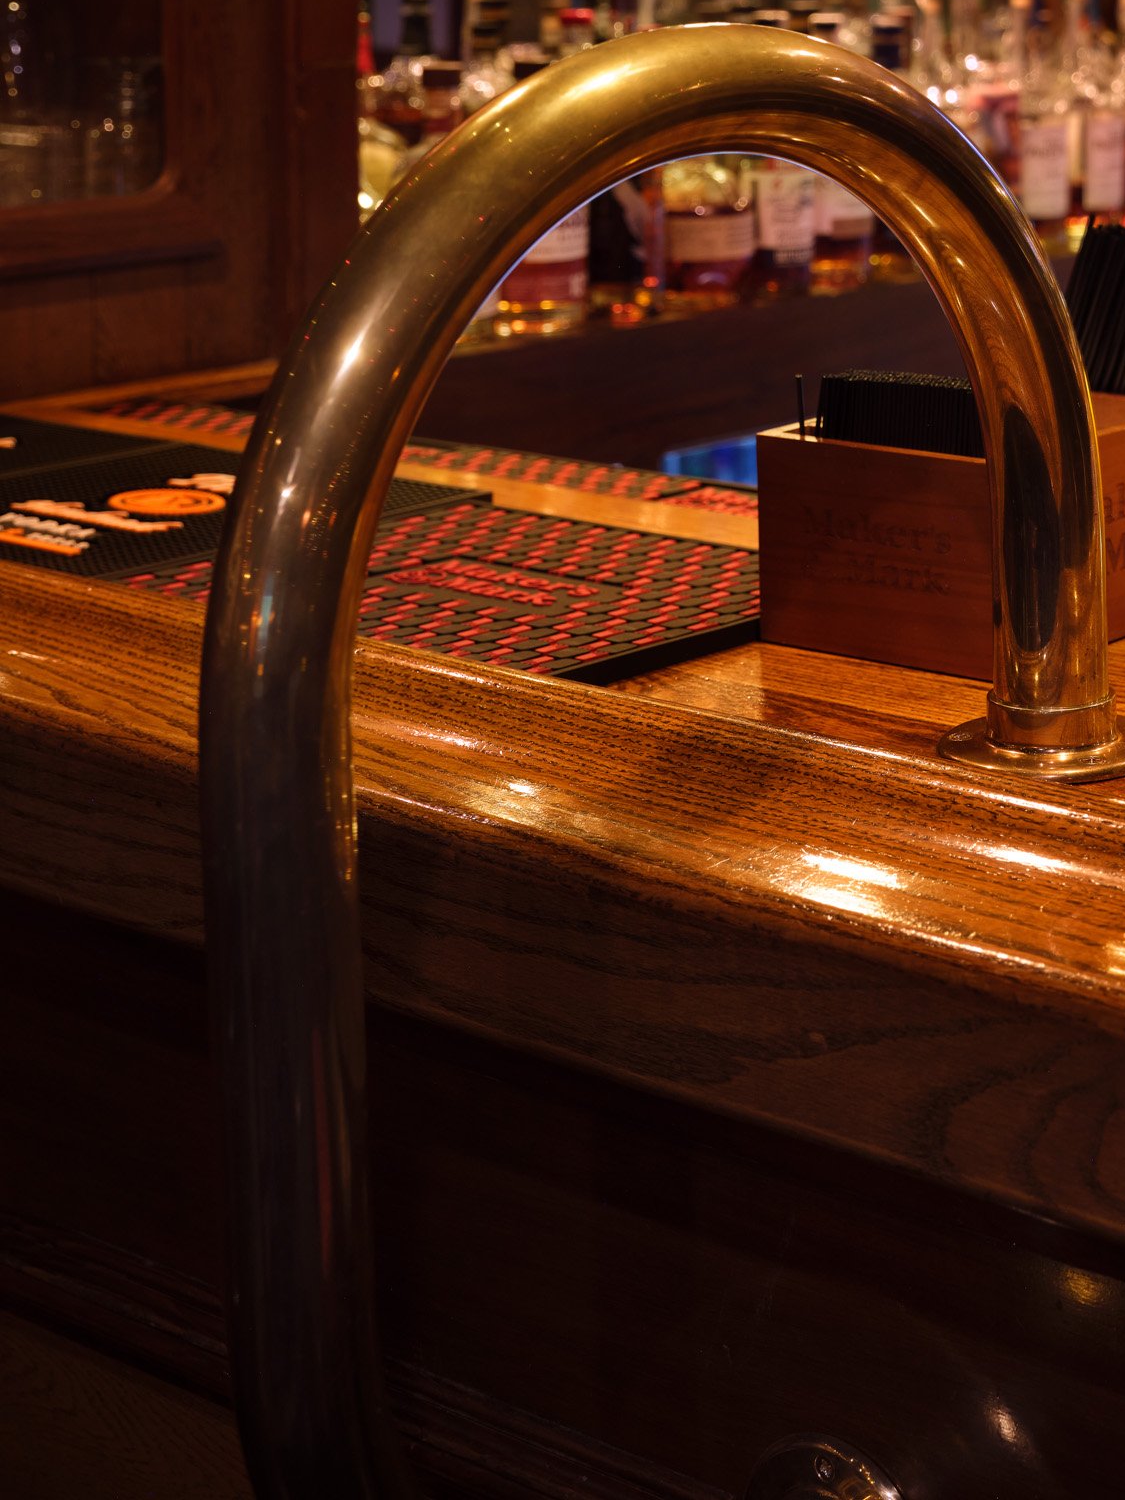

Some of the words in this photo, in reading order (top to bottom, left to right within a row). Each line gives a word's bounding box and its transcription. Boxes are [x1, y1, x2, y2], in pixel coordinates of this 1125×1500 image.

[800, 502, 951, 554] Maker's
[430, 576, 557, 606] Mark
[845, 552, 950, 595] Mark
